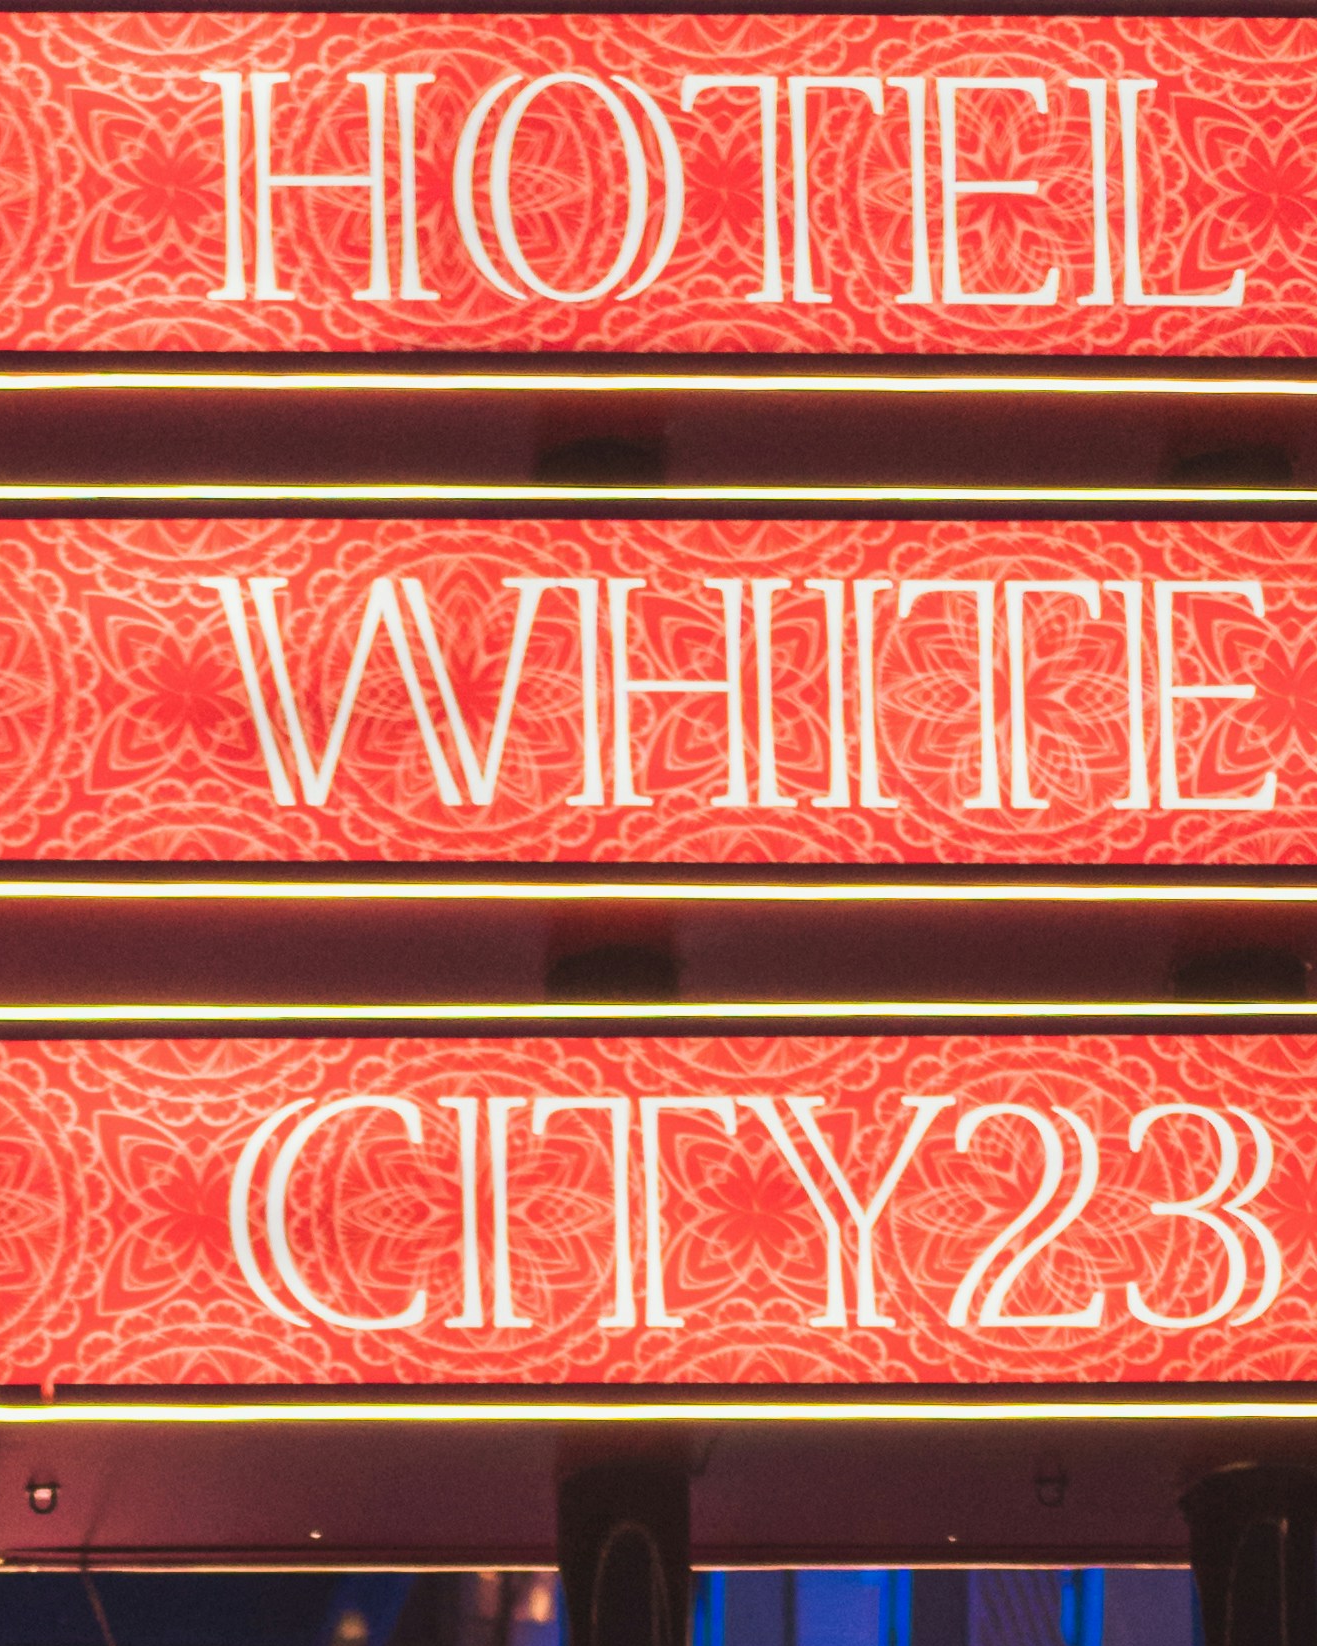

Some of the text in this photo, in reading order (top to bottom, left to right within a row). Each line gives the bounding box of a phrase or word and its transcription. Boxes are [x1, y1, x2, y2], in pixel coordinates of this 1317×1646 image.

[201, 71, 1246, 307] HOTEL
[200, 577, 1277, 811] WHITE
[229, 1095, 1284, 1331] CITY23
